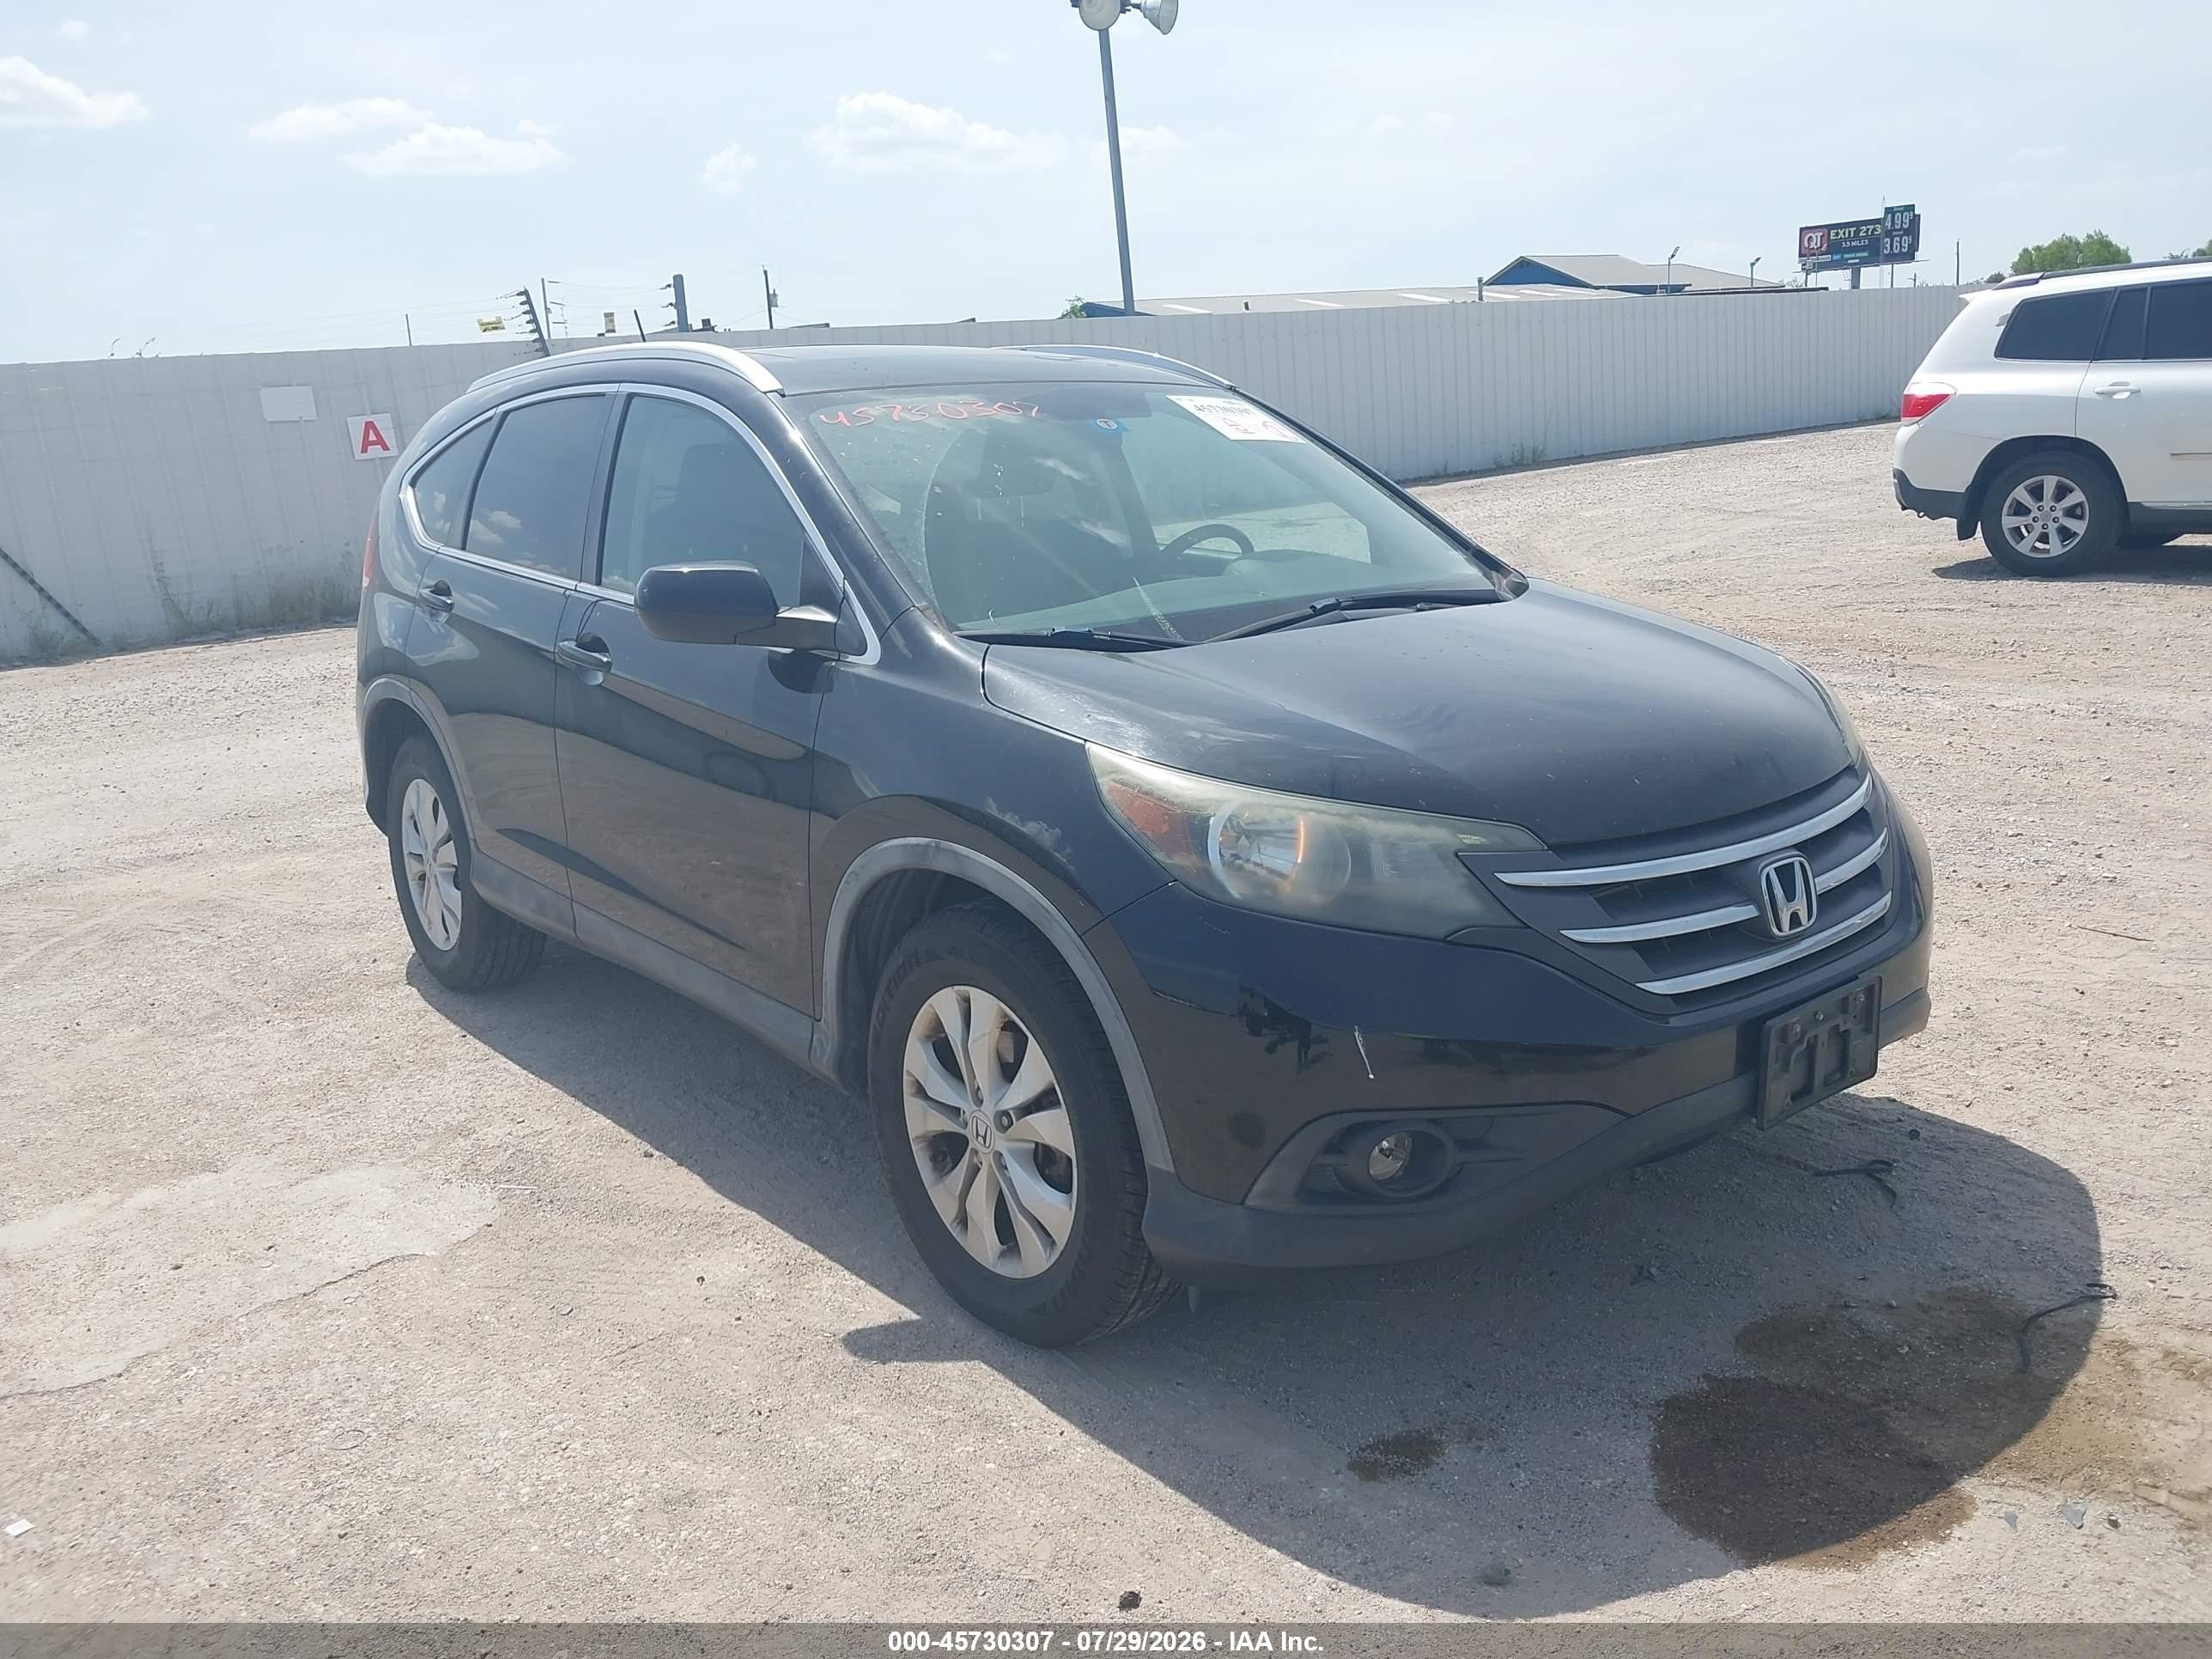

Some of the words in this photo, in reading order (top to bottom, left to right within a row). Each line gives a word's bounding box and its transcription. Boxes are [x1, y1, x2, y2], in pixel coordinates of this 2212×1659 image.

[1830, 228, 1856, 240] EXIT
[1859, 224, 1881, 237] 273
[360, 420, 391, 454] A
